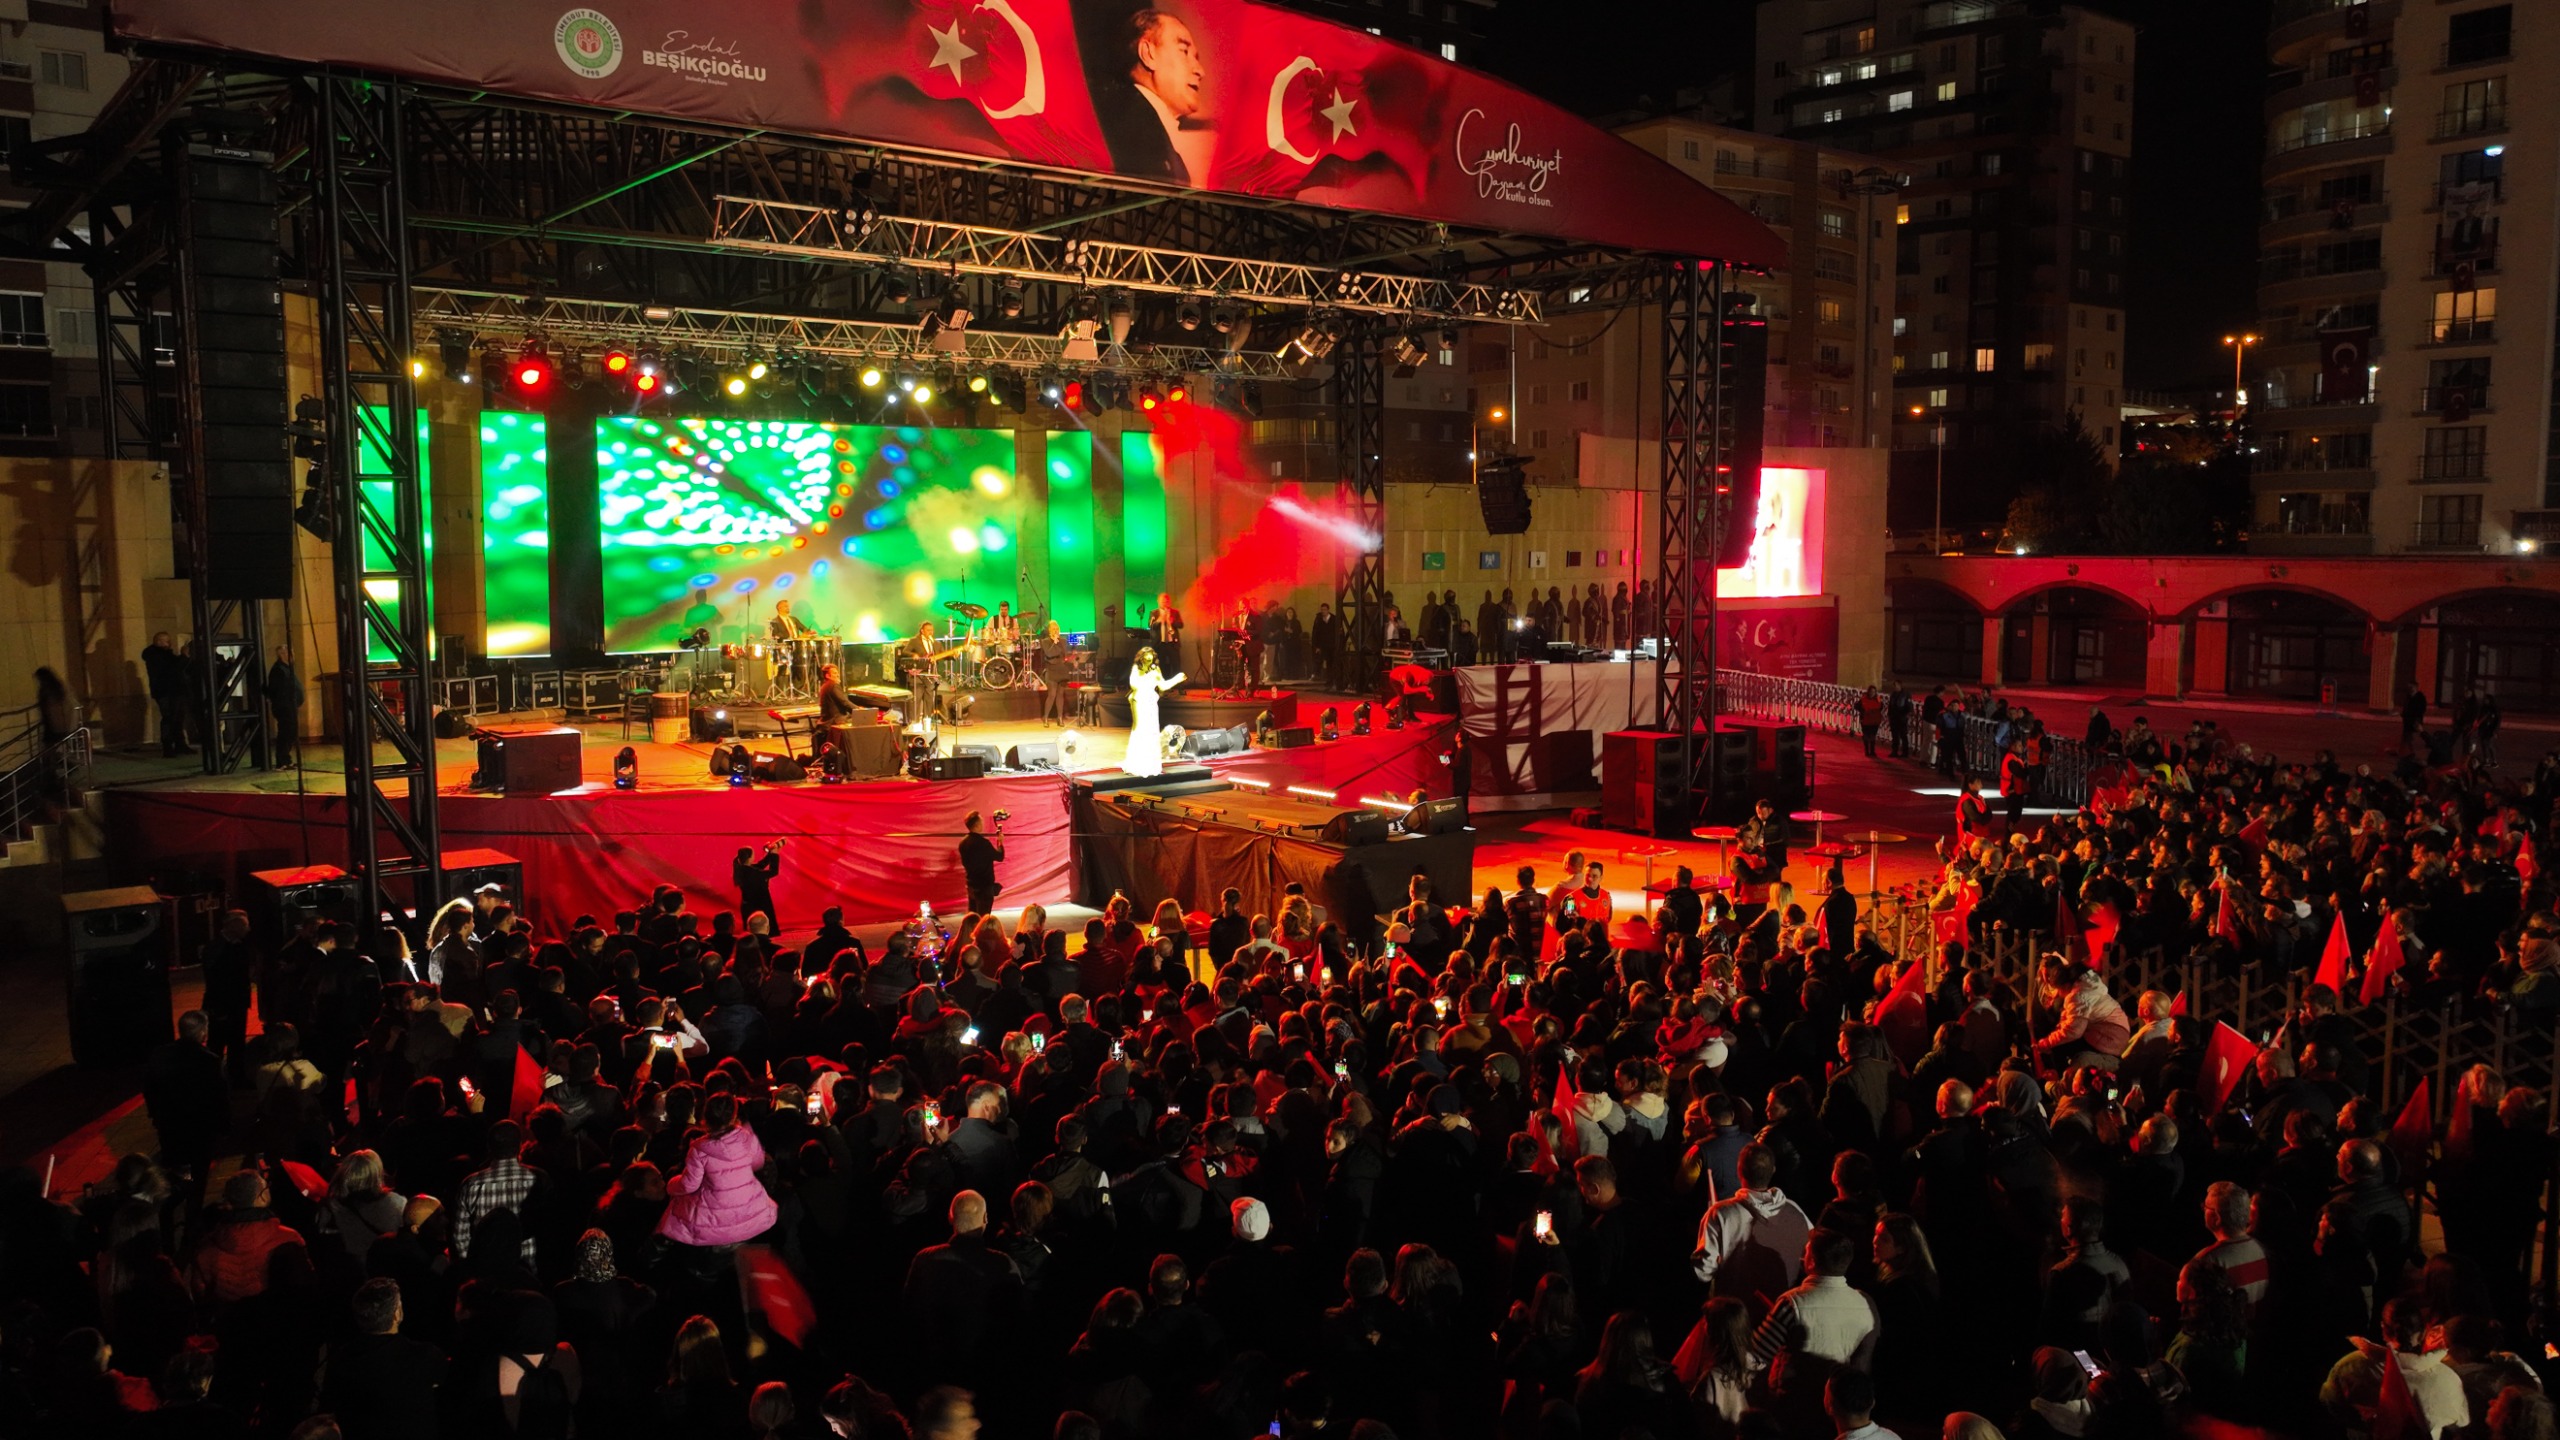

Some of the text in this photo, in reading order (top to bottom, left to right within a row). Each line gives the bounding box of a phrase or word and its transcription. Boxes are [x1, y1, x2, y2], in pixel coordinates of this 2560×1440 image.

[557, 11, 621, 52] ETİMESGUT BELEDİYESİ
[661, 30, 741, 56] Erdal
[581, 68, 600, 77] 1990
[642, 49, 767, 82] BEŞİKÇİOĞLU
[1456, 108, 1563, 193] Cumhuriyet
[1505, 188, 1526, 203] kutlu
